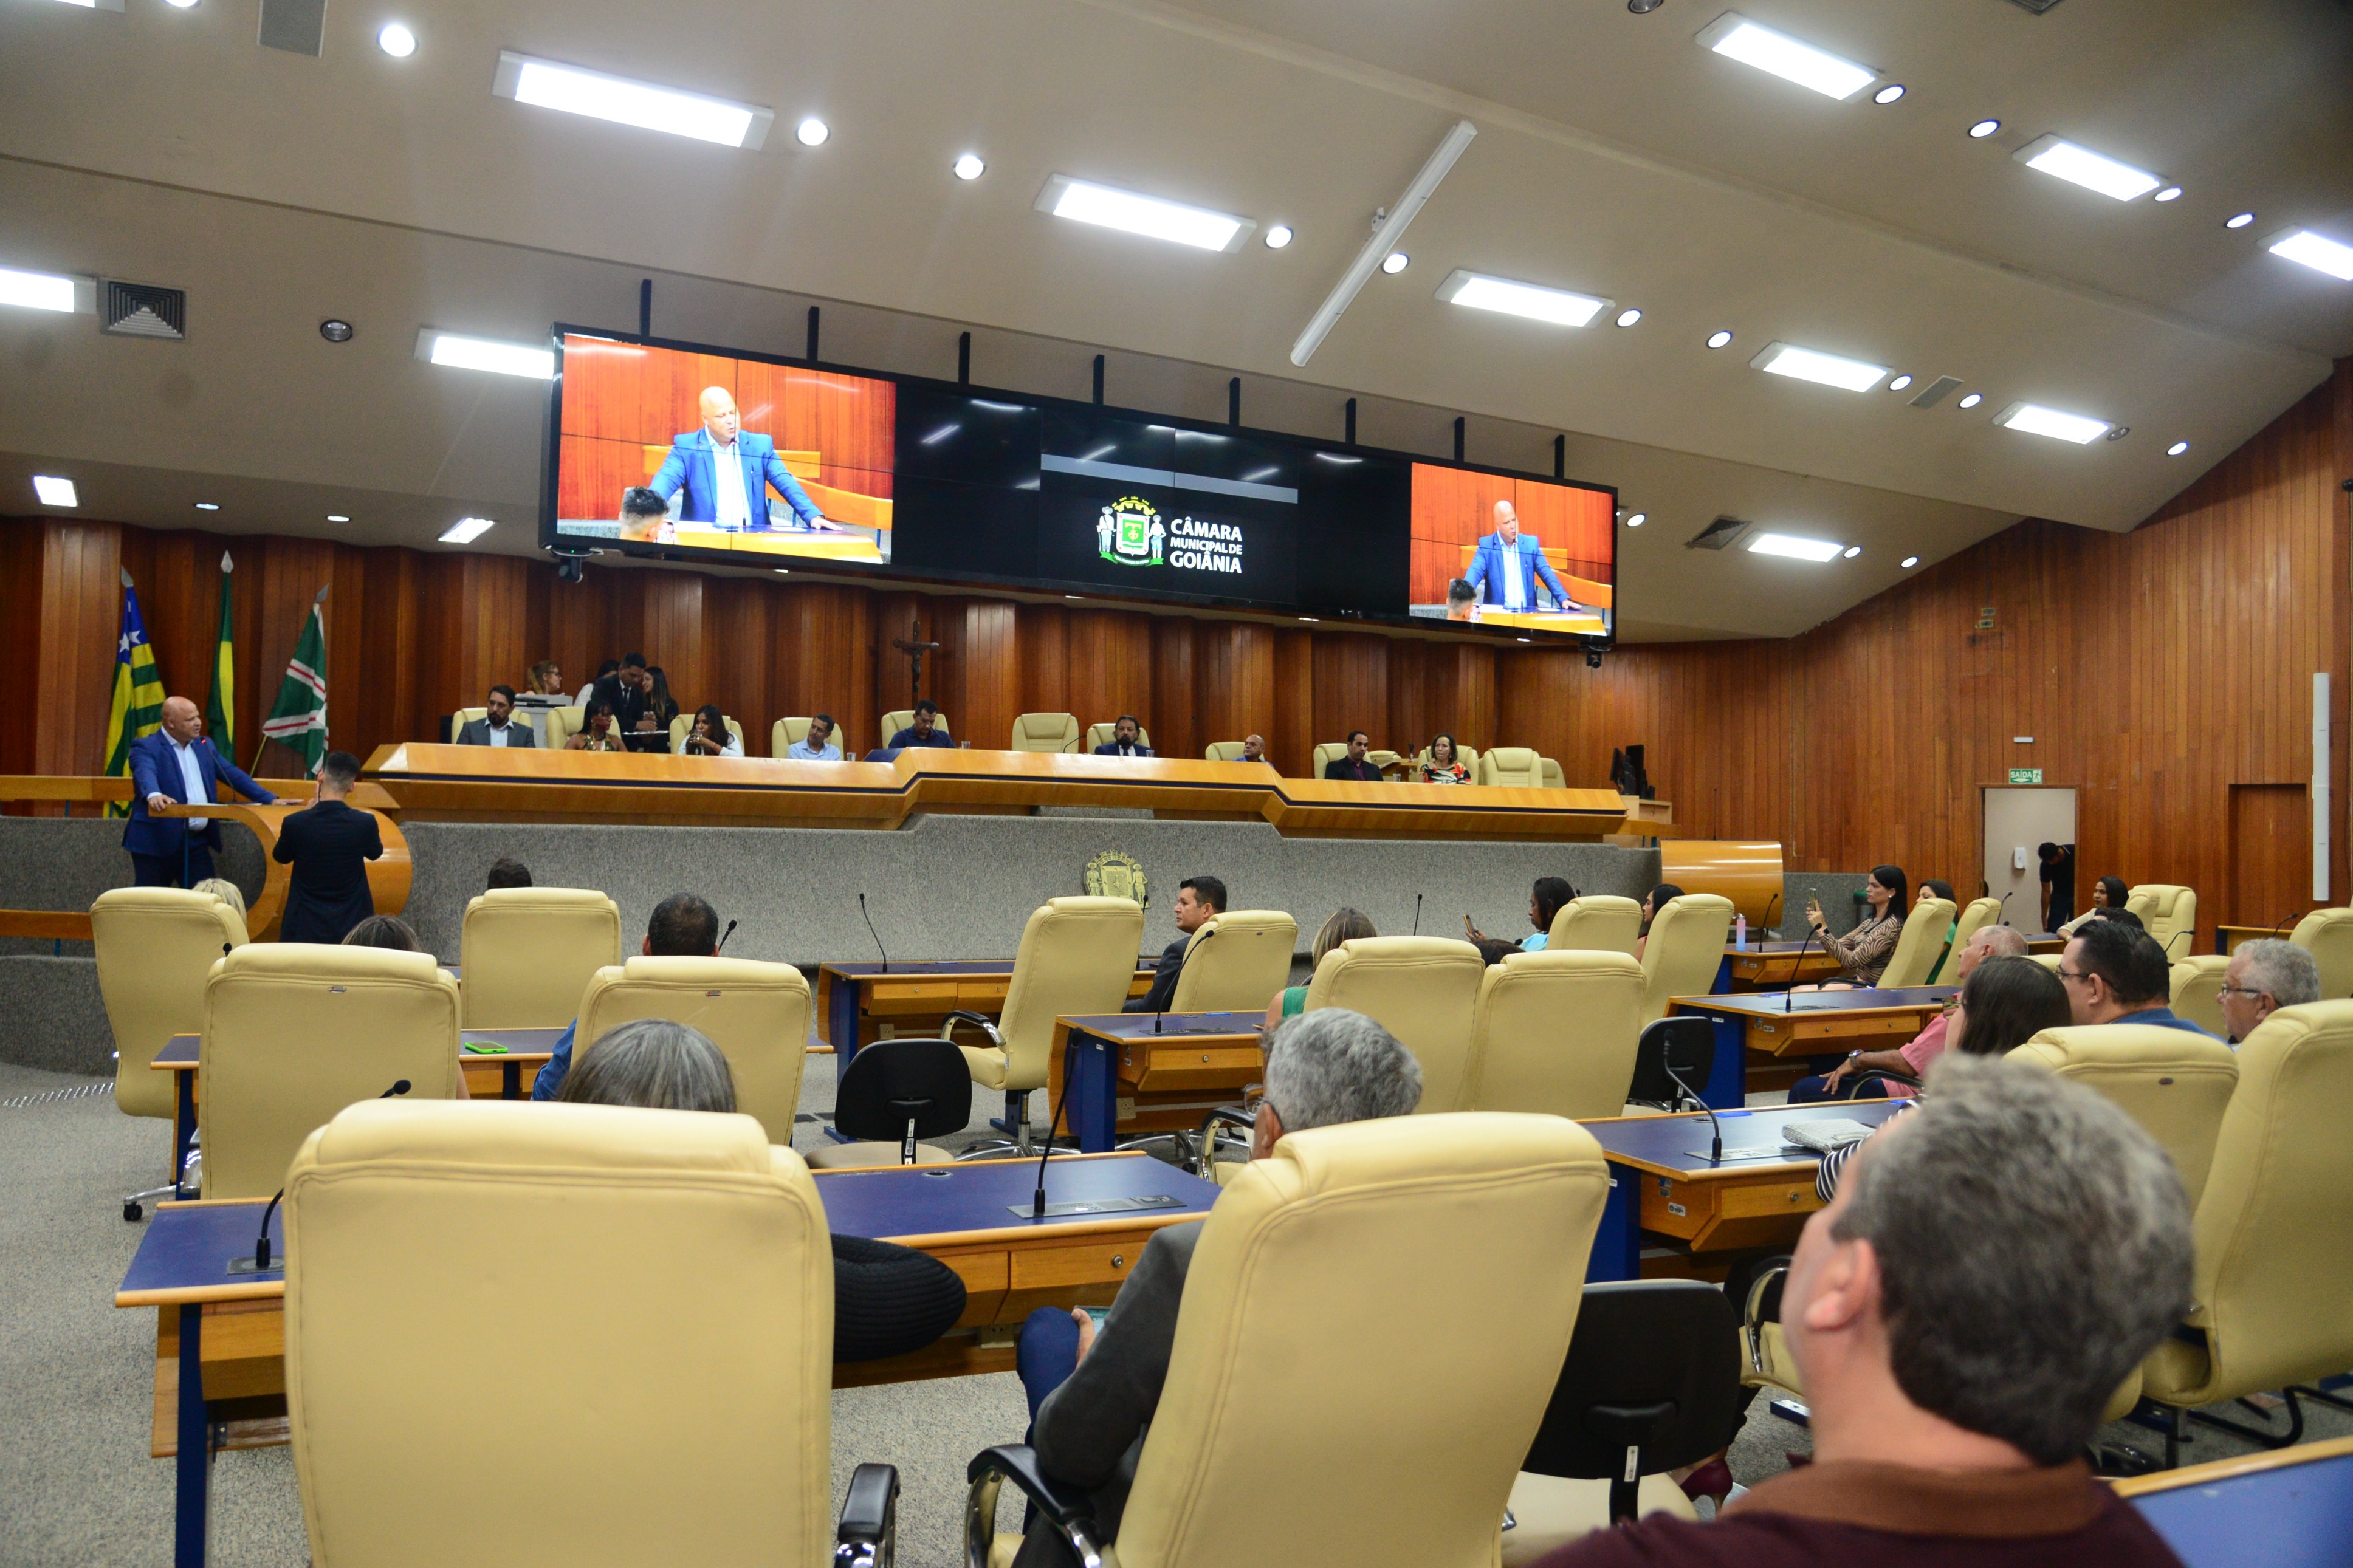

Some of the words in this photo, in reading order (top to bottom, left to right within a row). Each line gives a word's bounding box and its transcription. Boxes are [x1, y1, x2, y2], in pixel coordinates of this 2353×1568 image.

[1170, 516, 1242, 541] CÂMARA
[1170, 536, 1228, 553] MUNICIPAL
[1228, 543, 1242, 555] DE
[1170, 550, 1242, 573] GOIÂNIA
[2010, 770, 2032, 778] SAÍDA
